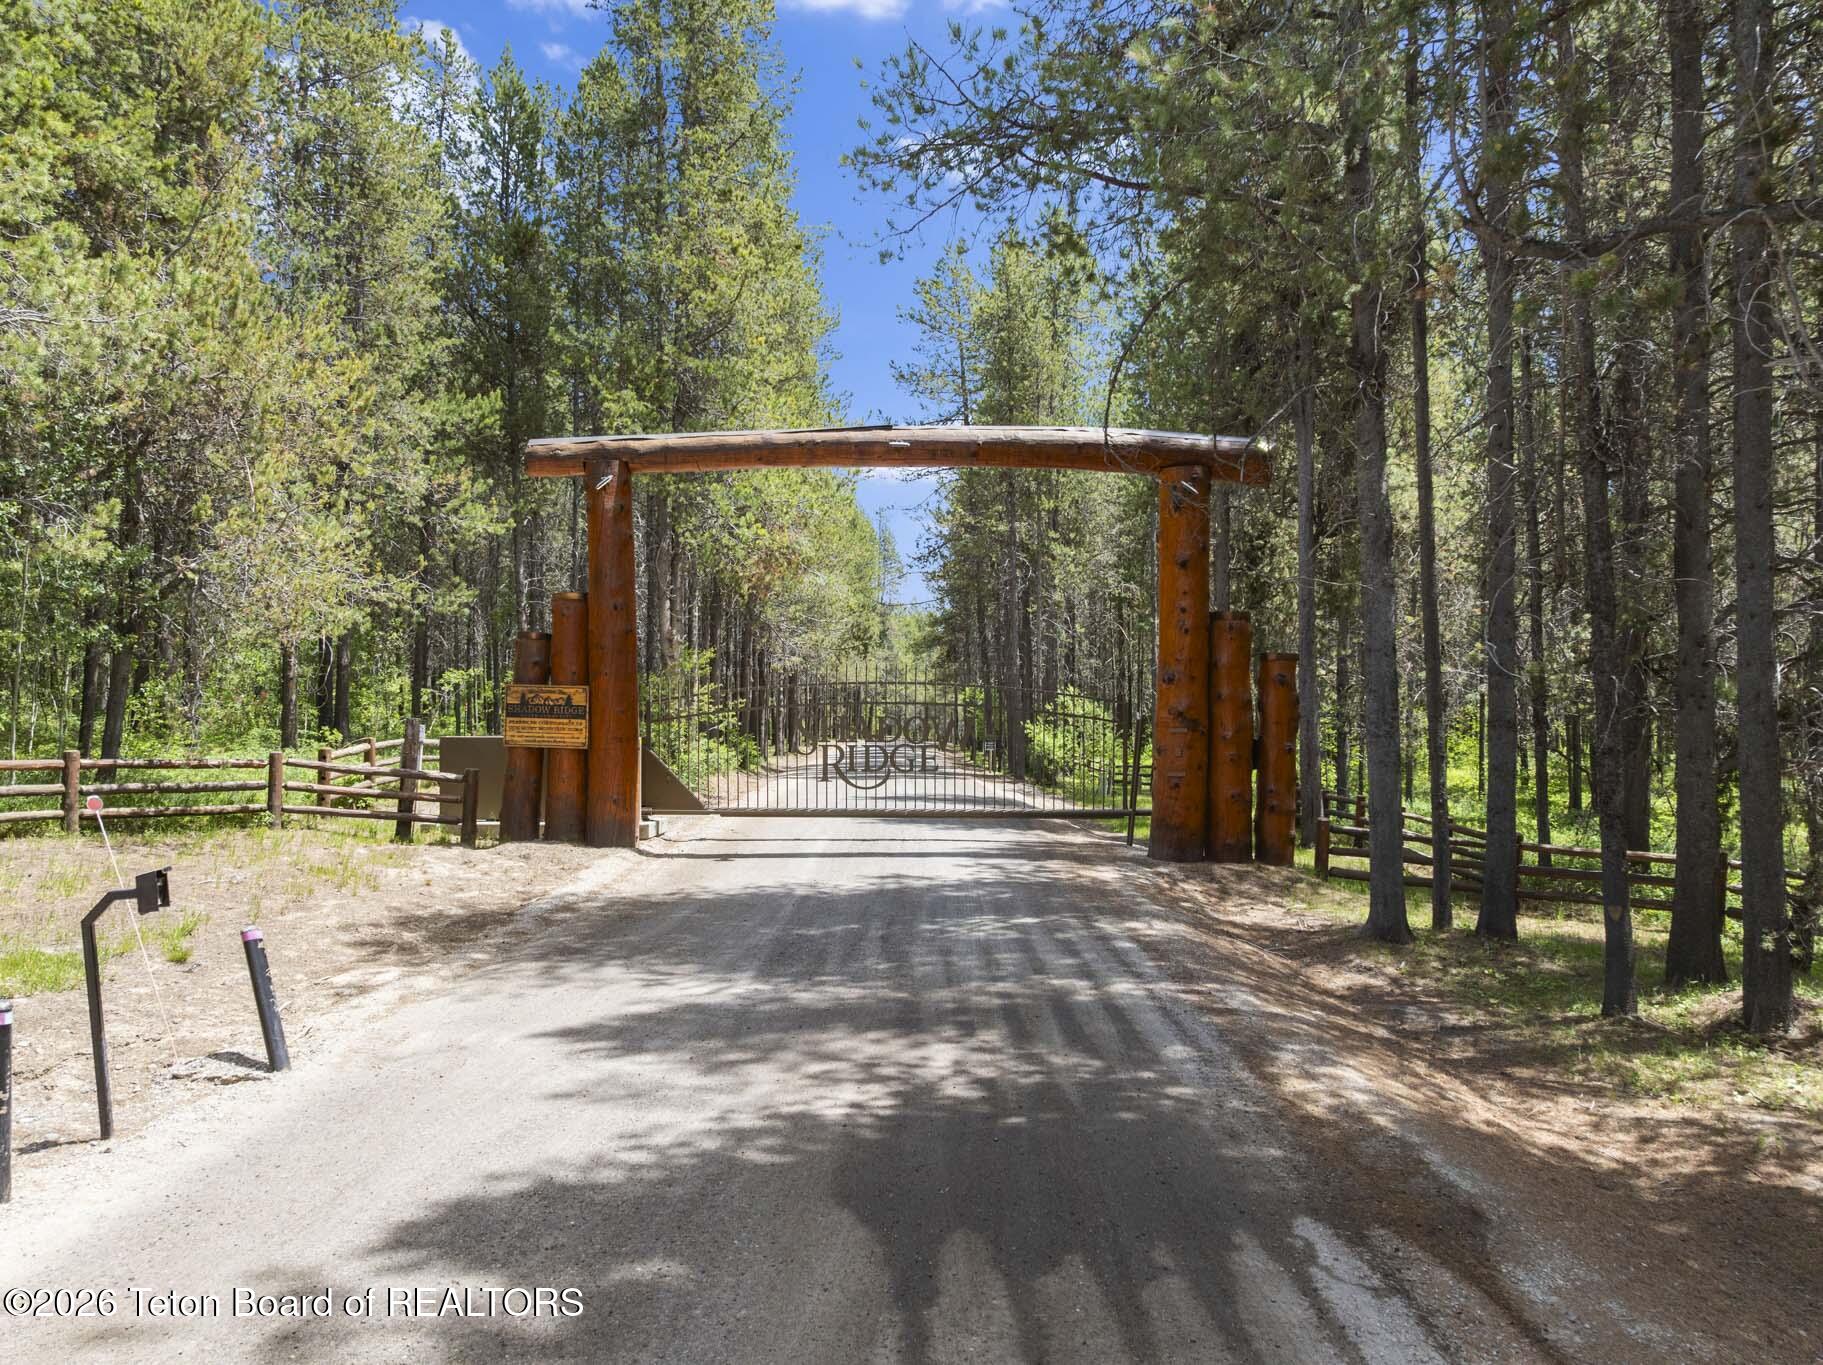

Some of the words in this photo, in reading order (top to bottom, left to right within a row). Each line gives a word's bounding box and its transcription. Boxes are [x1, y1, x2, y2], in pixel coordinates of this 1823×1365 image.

[508, 704, 550, 714] SHADOW
[554, 706, 584, 715] RIDGE
[795, 712, 976, 756] SHADOW
[818, 744, 939, 790] RIDGE
